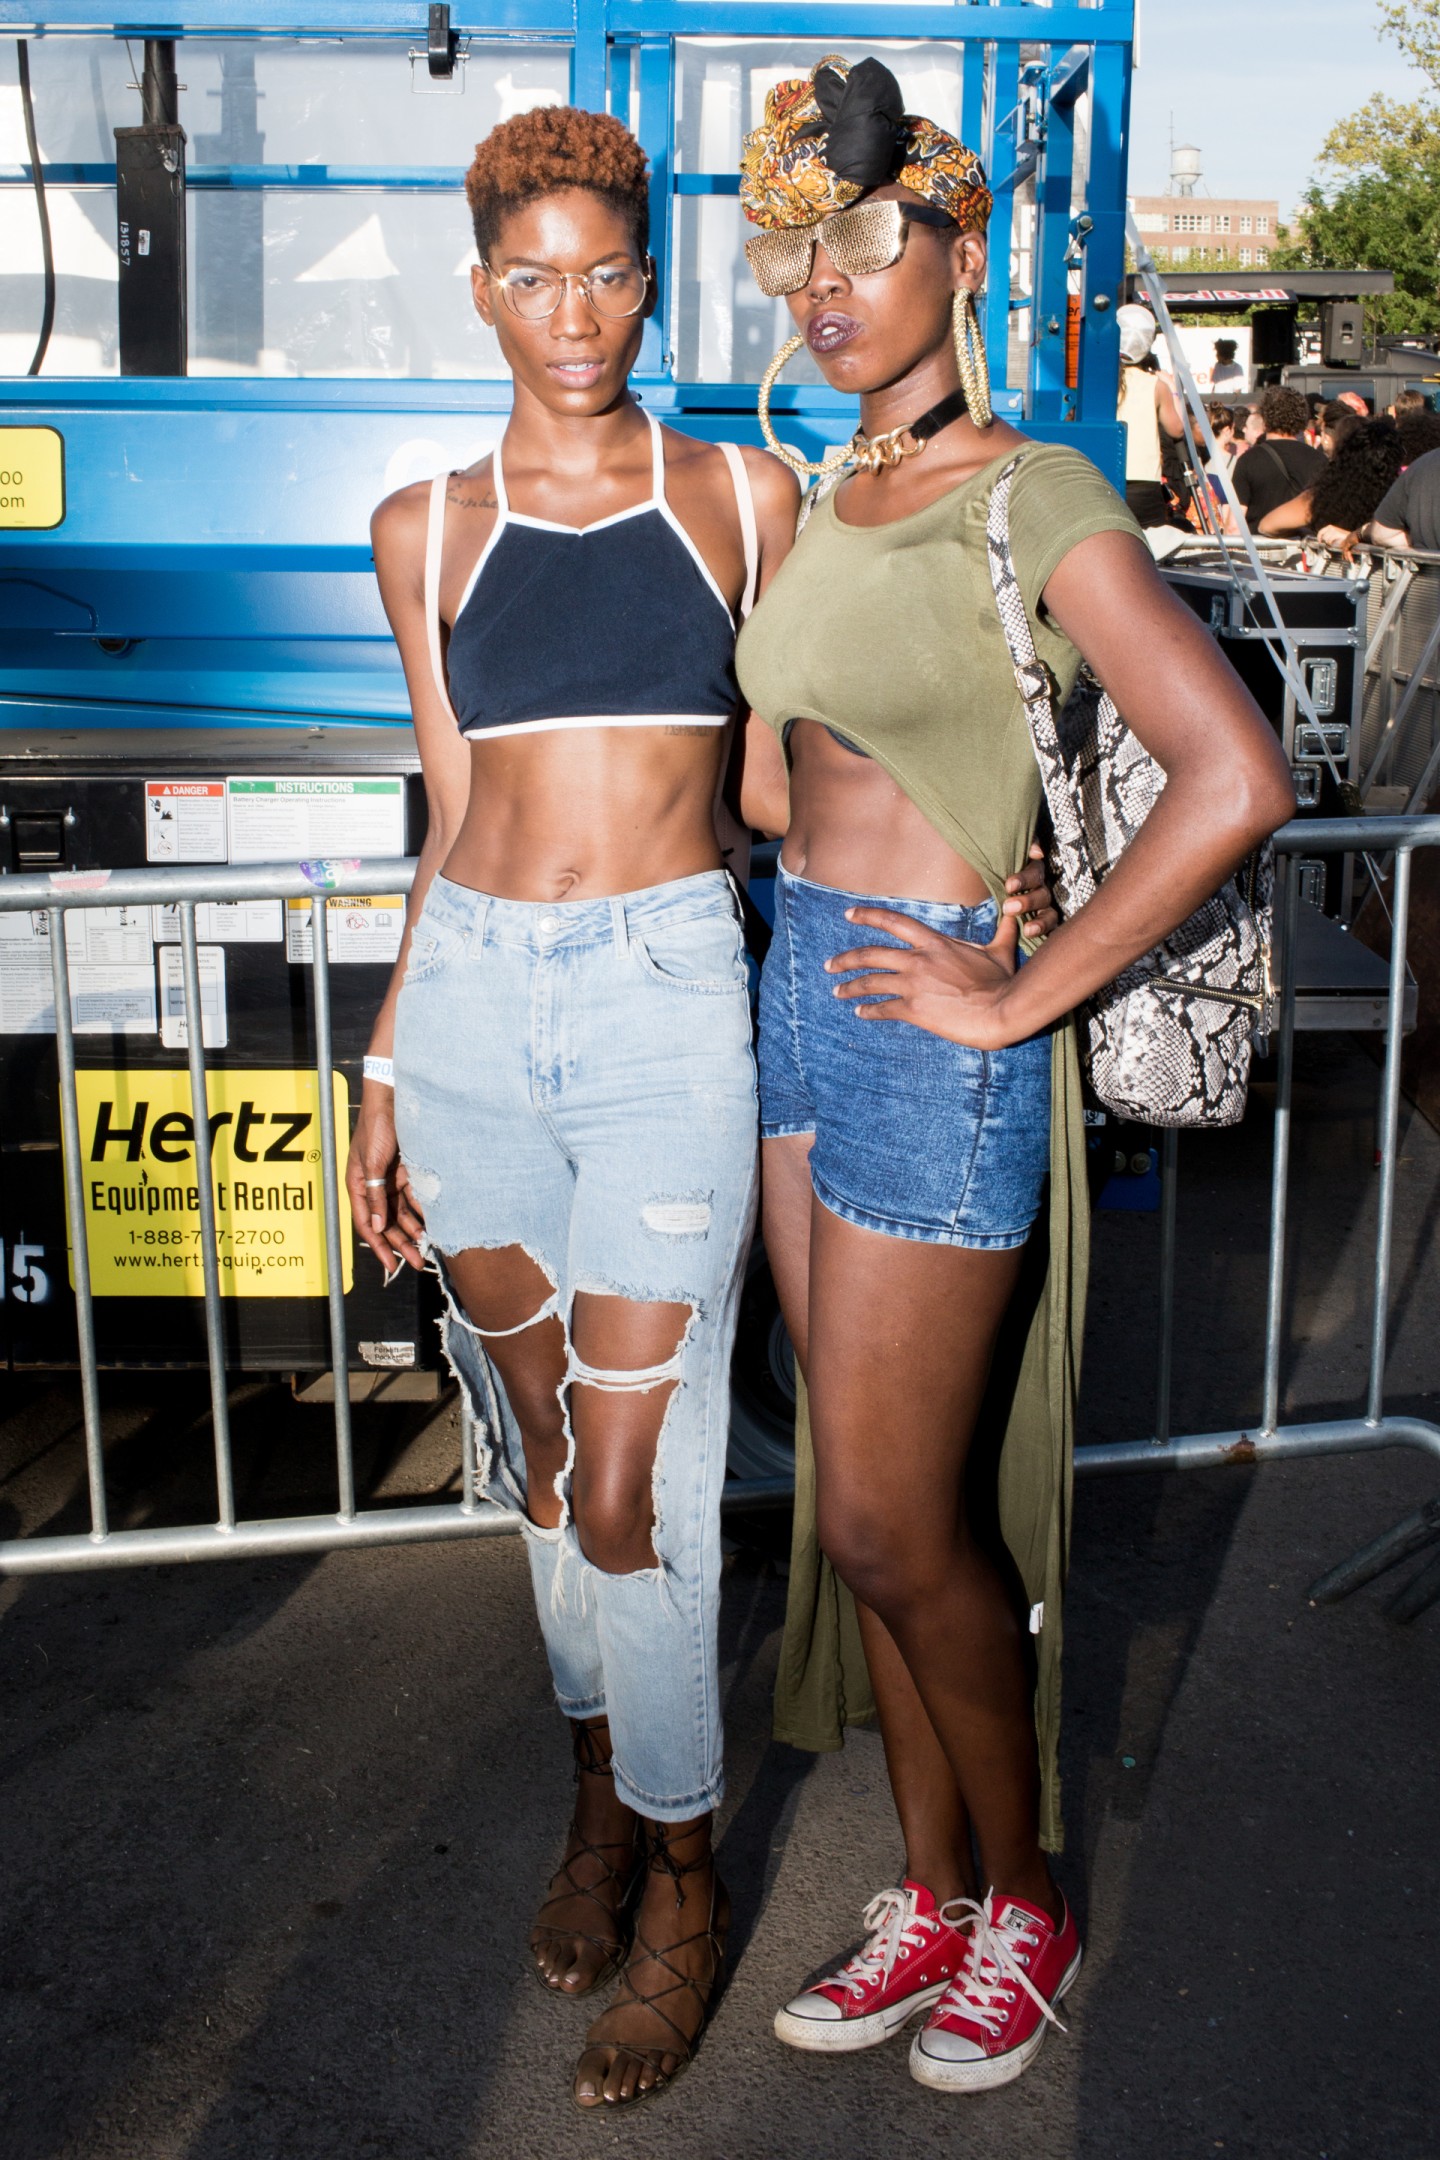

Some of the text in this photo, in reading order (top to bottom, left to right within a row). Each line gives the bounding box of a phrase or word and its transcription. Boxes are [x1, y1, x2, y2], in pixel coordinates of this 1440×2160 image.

[120, 221, 130, 266] 131857
[1212, 288, 1290, 301] Bull
[172, 786, 209, 795] DANGER
[275, 782, 355, 793] INSTRUCTIONS
[329, 898, 372, 907] WARNING
[91, 1102, 313, 1163] Hertz
[91, 1181, 313, 1215] Equipmet Rental
[128, 1230, 285, 1245] 1-888-77-2700
[114, 1253, 305, 1270] www.hertquip.com
